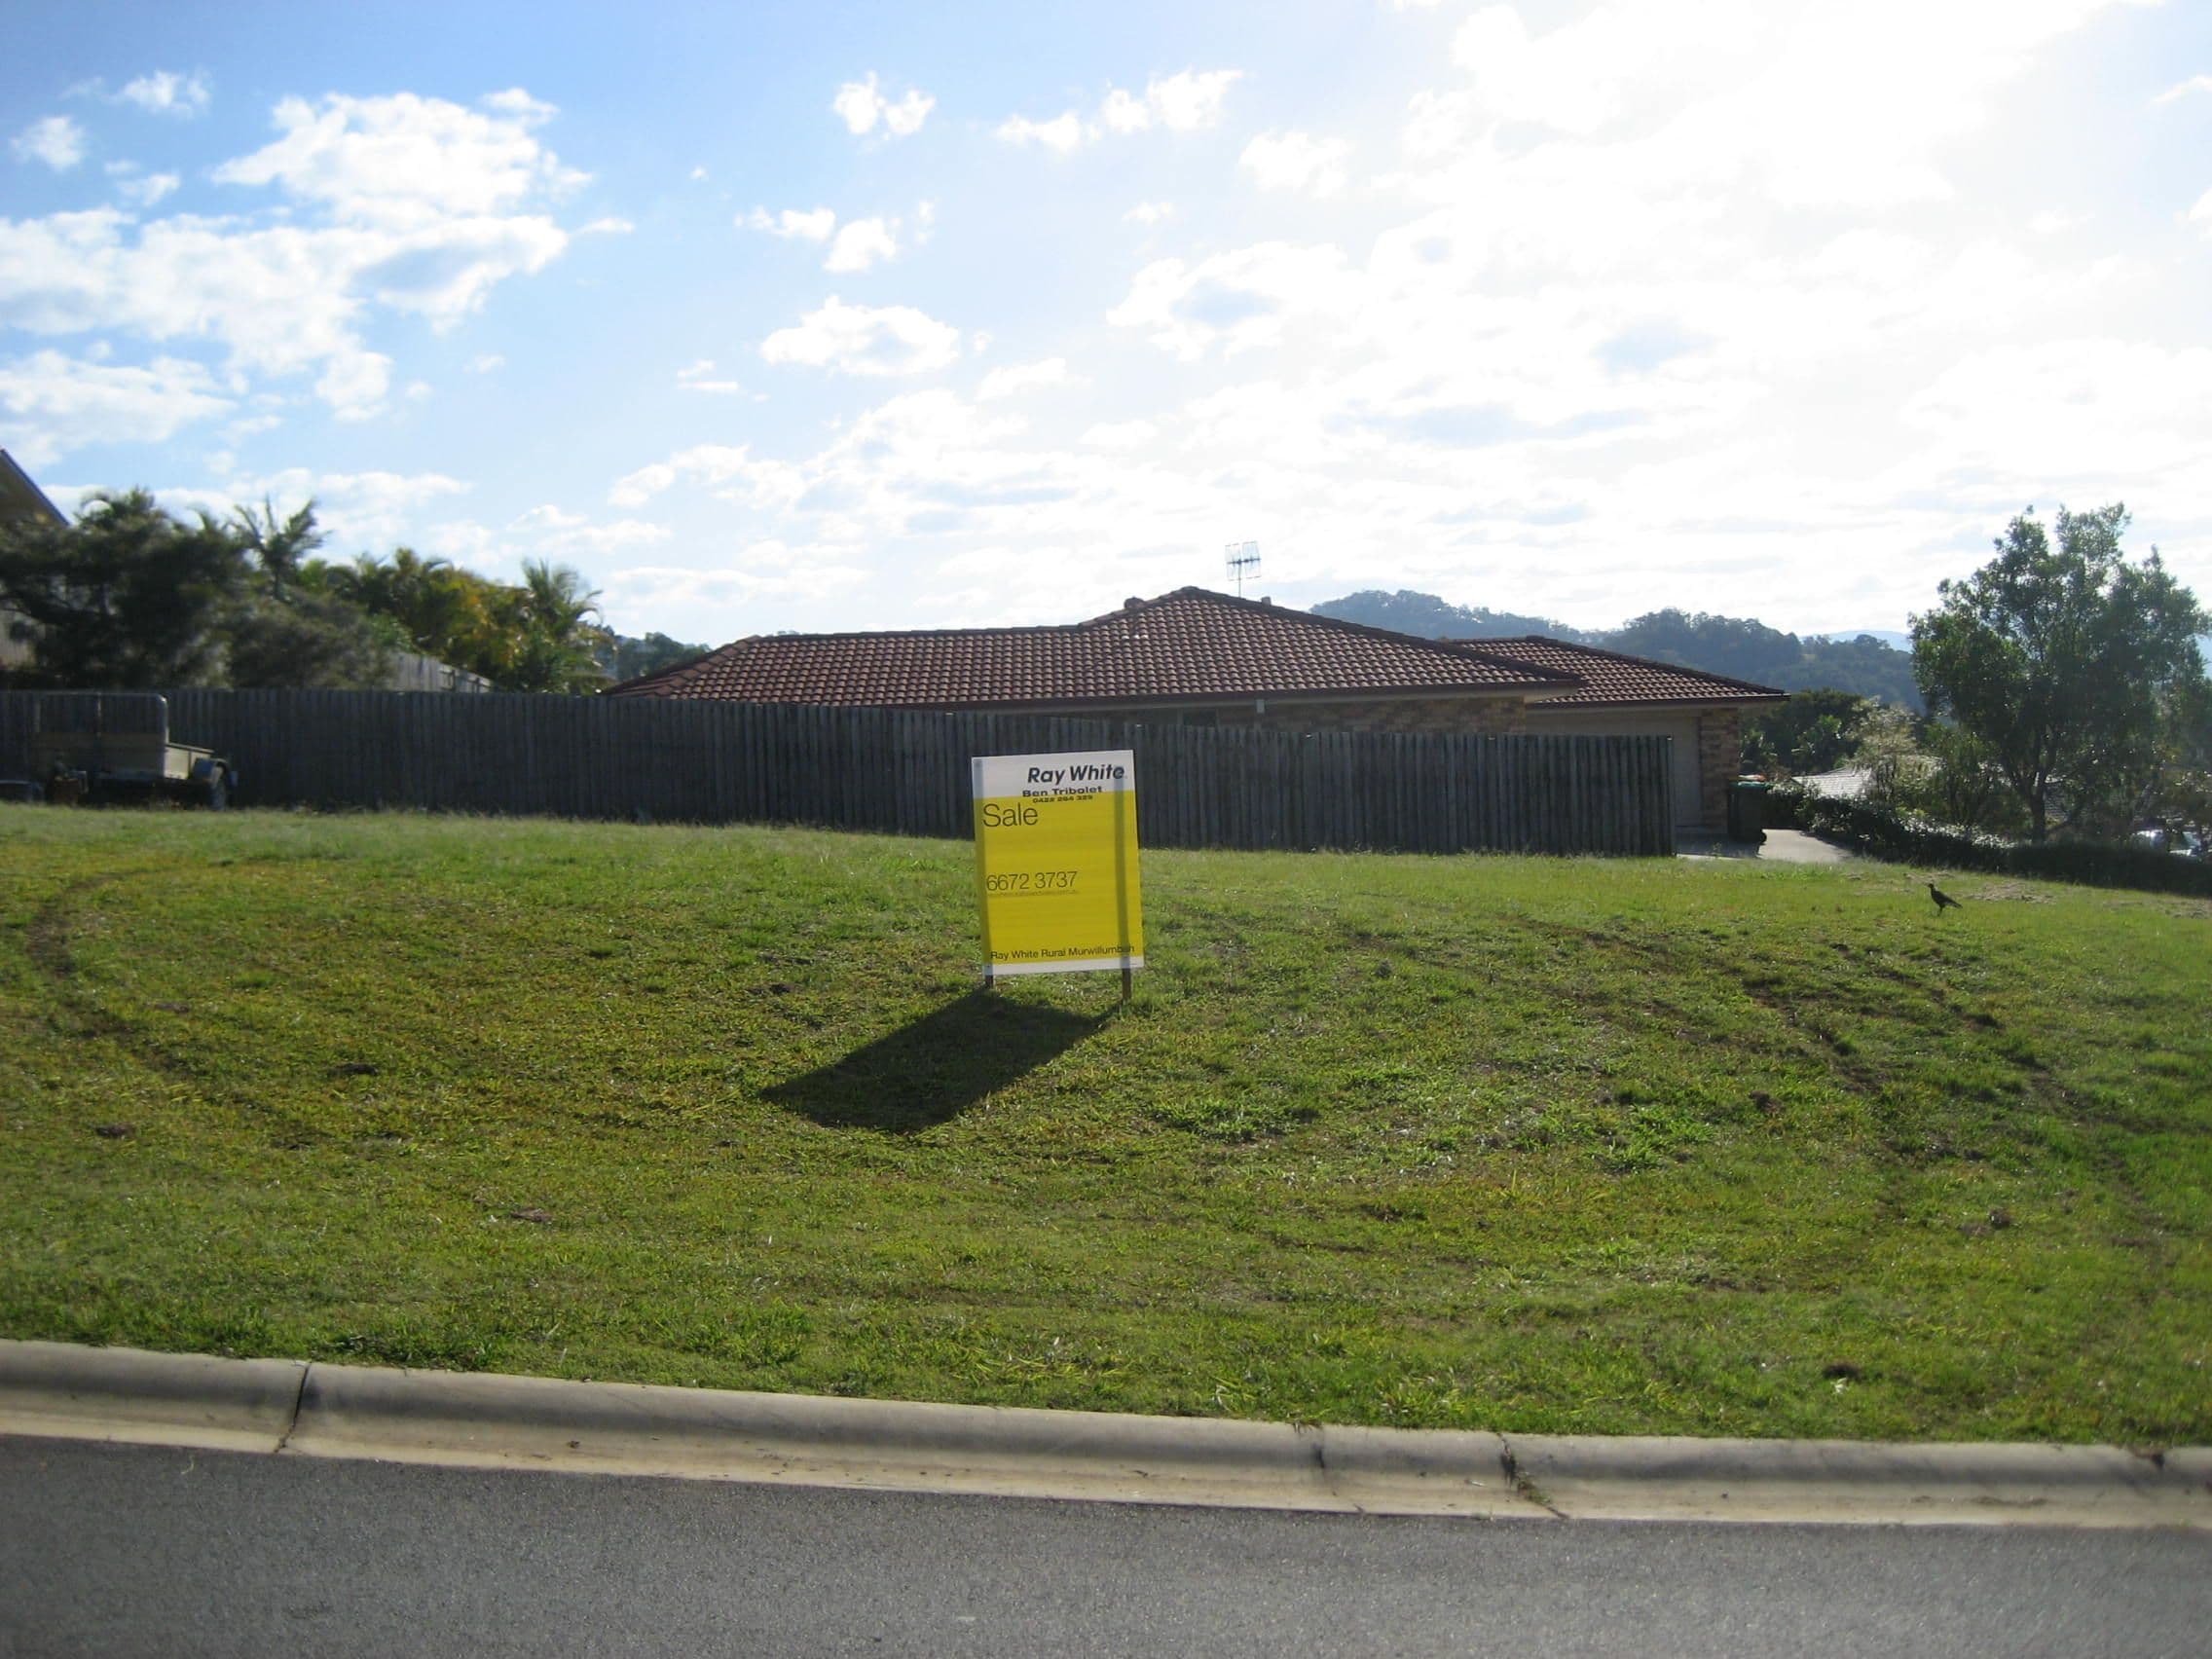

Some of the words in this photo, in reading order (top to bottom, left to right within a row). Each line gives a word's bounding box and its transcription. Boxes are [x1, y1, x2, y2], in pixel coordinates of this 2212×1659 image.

[1027, 767, 1065, 786] Ray
[1070, 764, 1124, 782] White
[1051, 786, 1102, 795] Tribolet
[982, 803, 1038, 828] Sale
[986, 873, 1030, 891] 6672
[1035, 870, 1078, 889] 3737
[991, 950, 1009, 961] Ray
[1012, 949, 1038, 959] White
[1042, 948, 1066, 958] Rural
[1069, 944, 1134, 957] Murwillumbh
